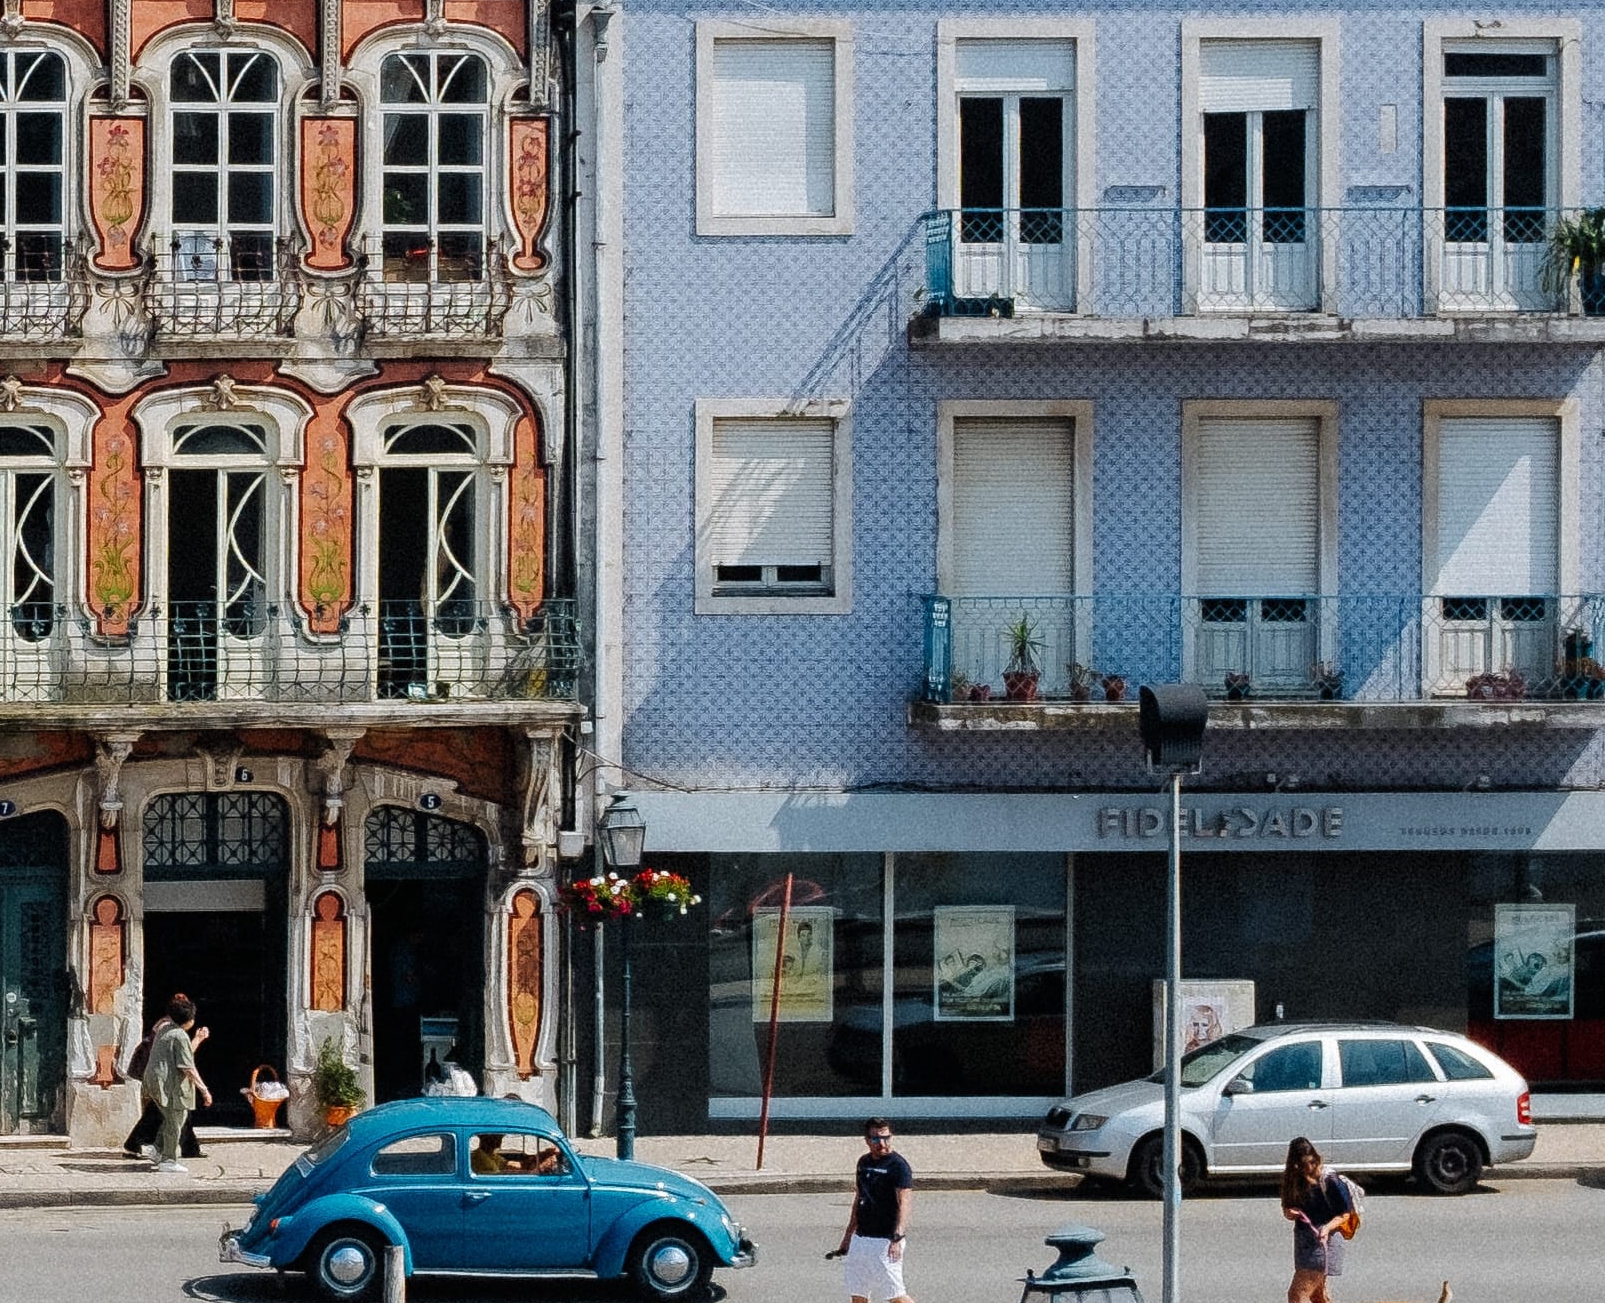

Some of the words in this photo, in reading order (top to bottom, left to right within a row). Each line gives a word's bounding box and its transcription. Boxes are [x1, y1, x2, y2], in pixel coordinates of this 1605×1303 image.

[241, 768, 248, 781] 6
[427, 795, 435, 808] 5
[1, 802, 9, 815] 7
[1100, 807, 1343, 838] FIDELDADE
